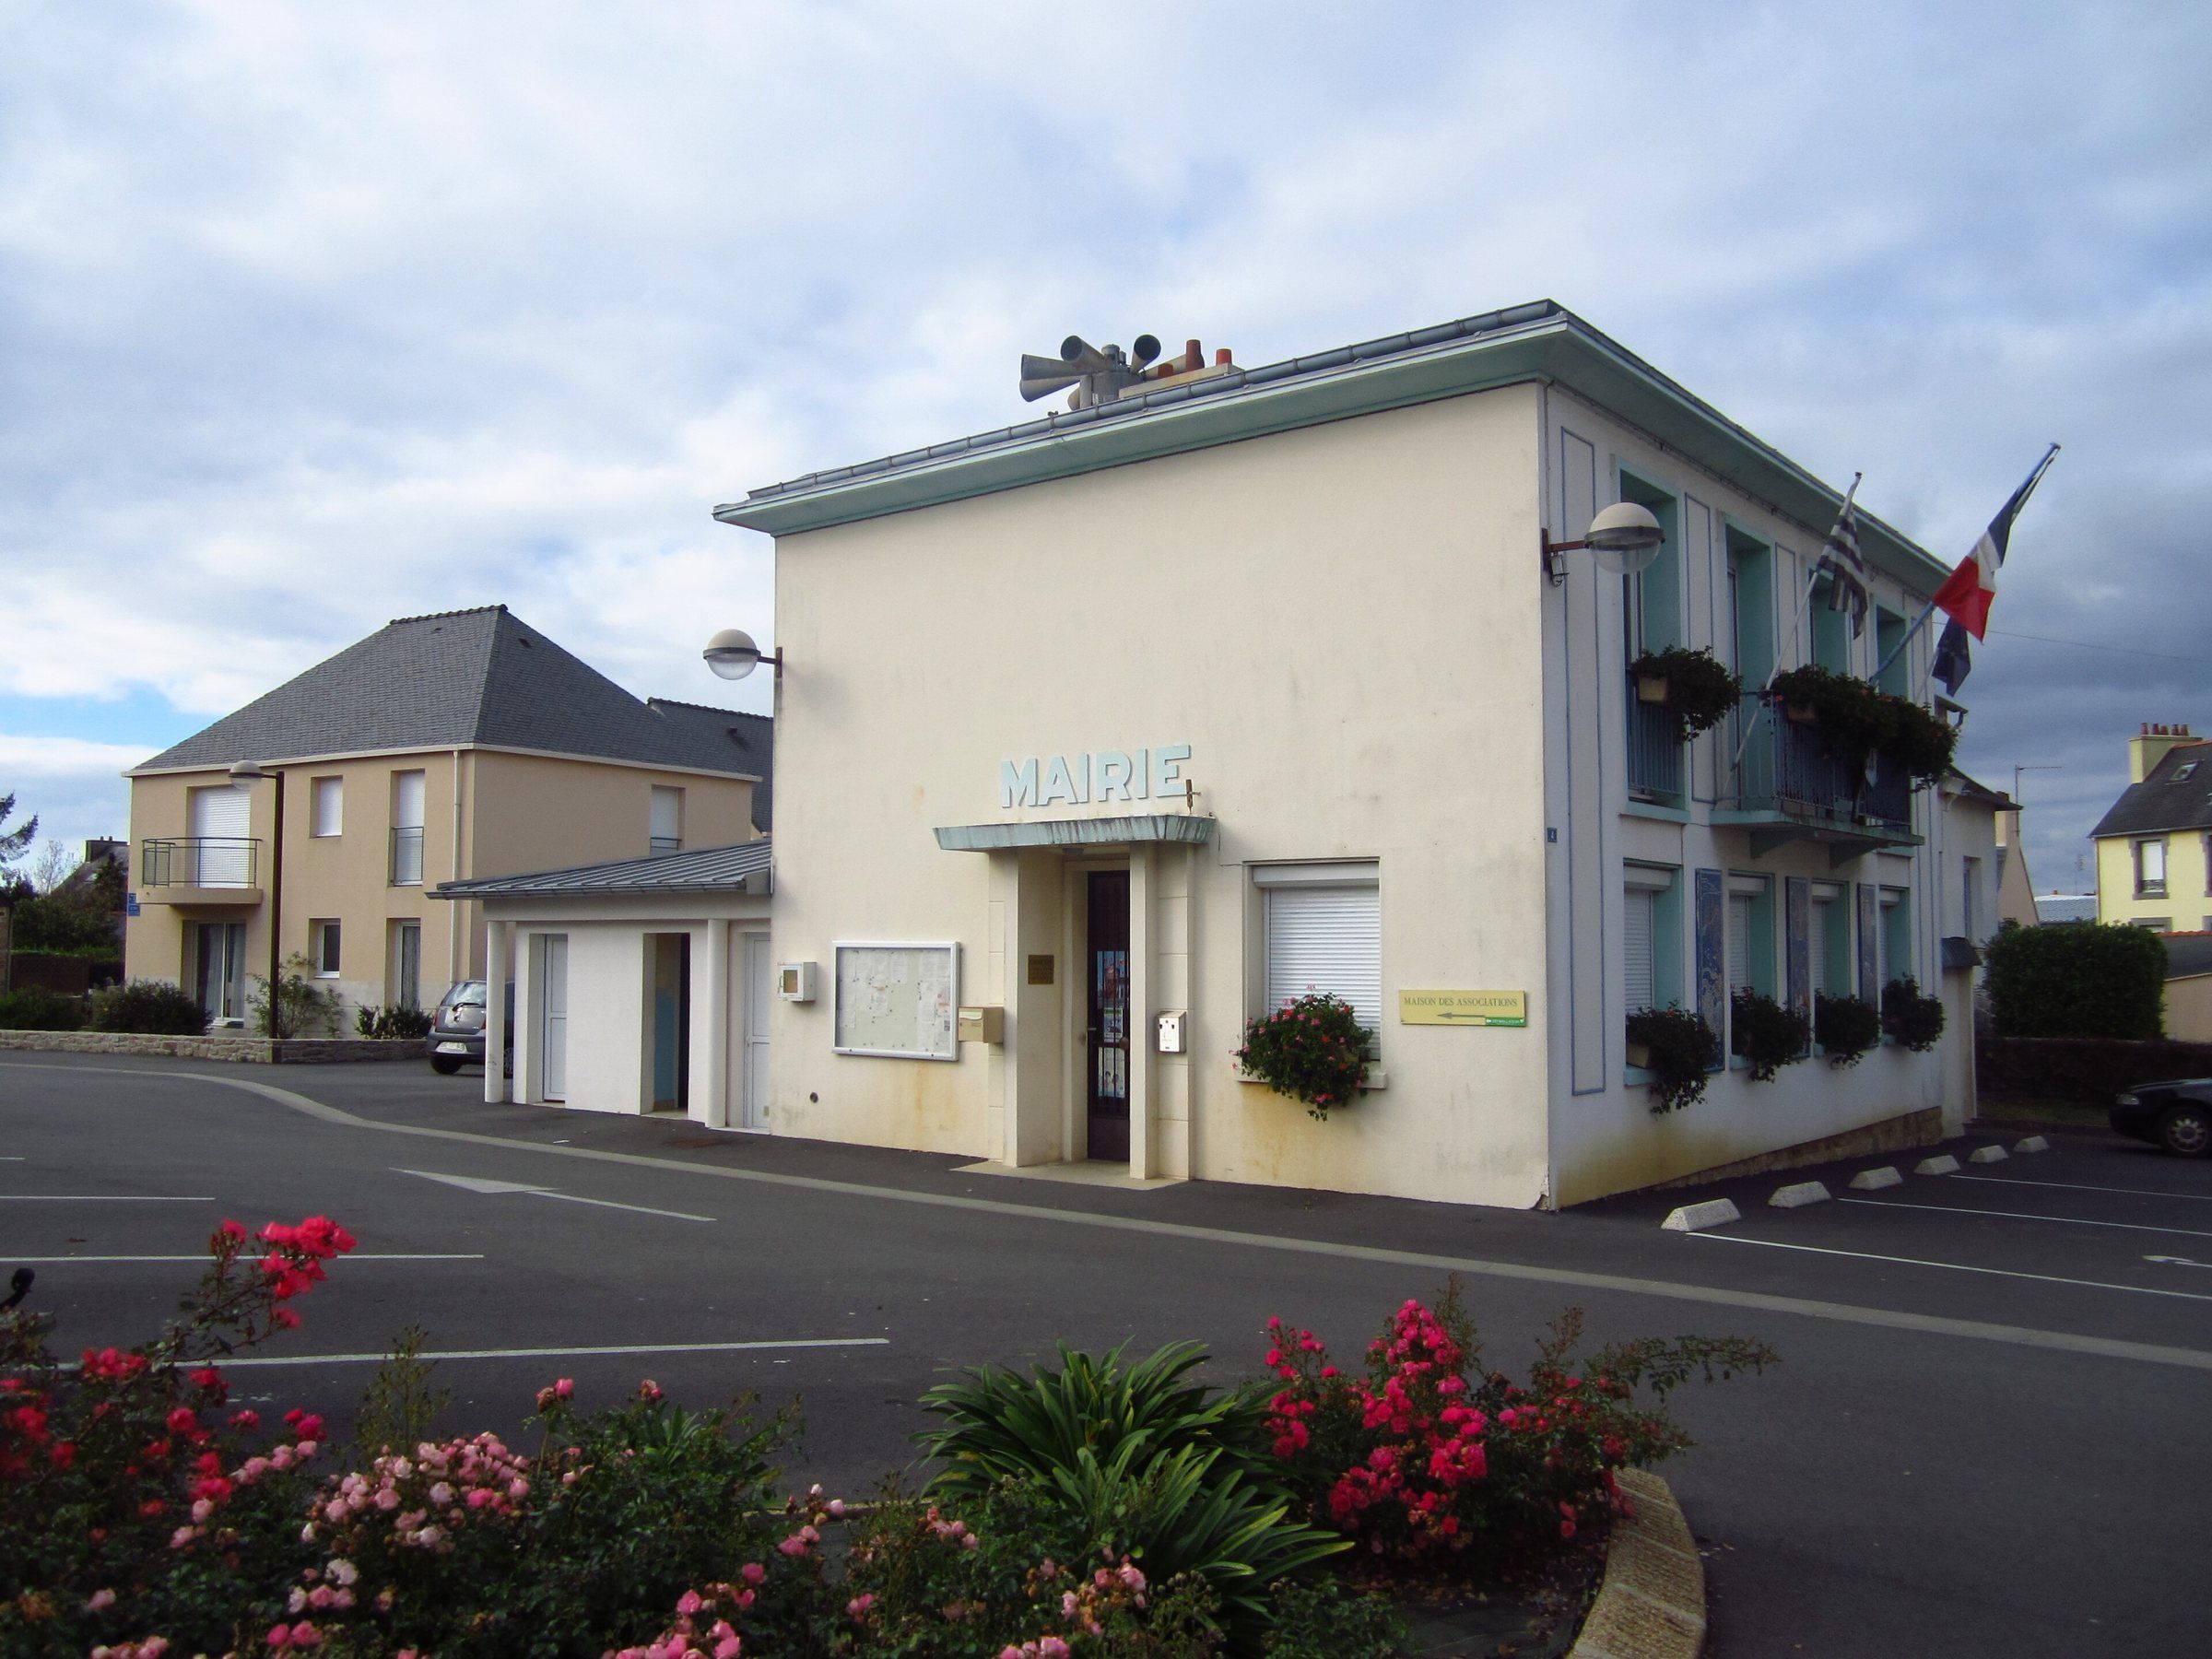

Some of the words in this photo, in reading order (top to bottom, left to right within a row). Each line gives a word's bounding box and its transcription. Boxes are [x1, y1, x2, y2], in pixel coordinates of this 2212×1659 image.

[1001, 744, 1191, 807] MAIRIE
[1404, 997, 1436, 1006] MAISON
[1439, 997, 1453, 1006] DES
[1456, 997, 1517, 1006] ASSOCIATIONS
